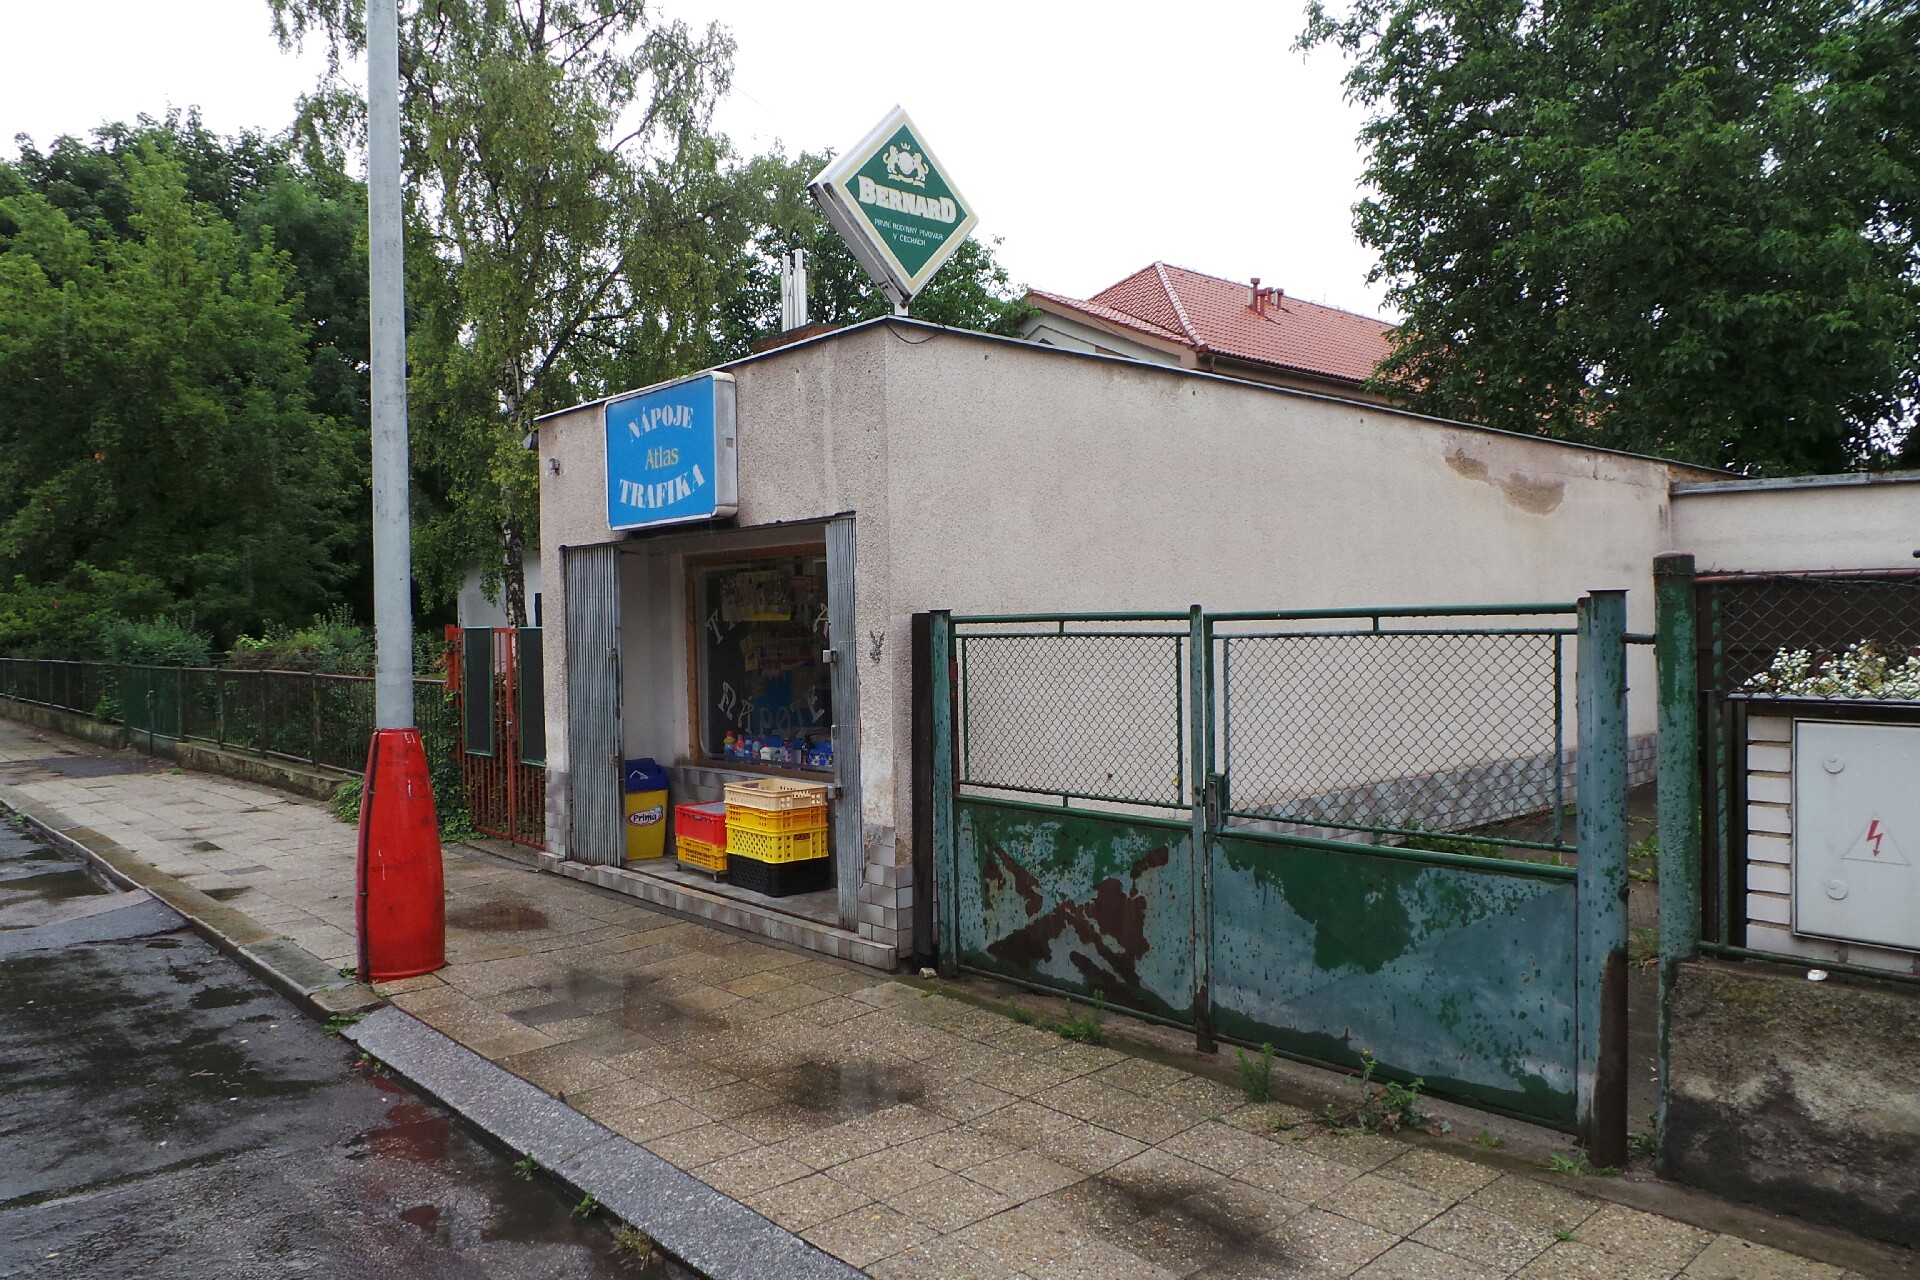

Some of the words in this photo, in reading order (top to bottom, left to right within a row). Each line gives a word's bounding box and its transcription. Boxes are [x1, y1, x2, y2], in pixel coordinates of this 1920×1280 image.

[858, 175, 956, 223] BERNARD
[892, 232, 898, 240] V
[919, 229, 944, 241] PIVOVAR
[628, 405, 693, 442] NÁPOJE
[645, 447, 679, 470] Atlas
[619, 463, 705, 508] TRAFIKA
[633, 813, 657, 823] Prima
